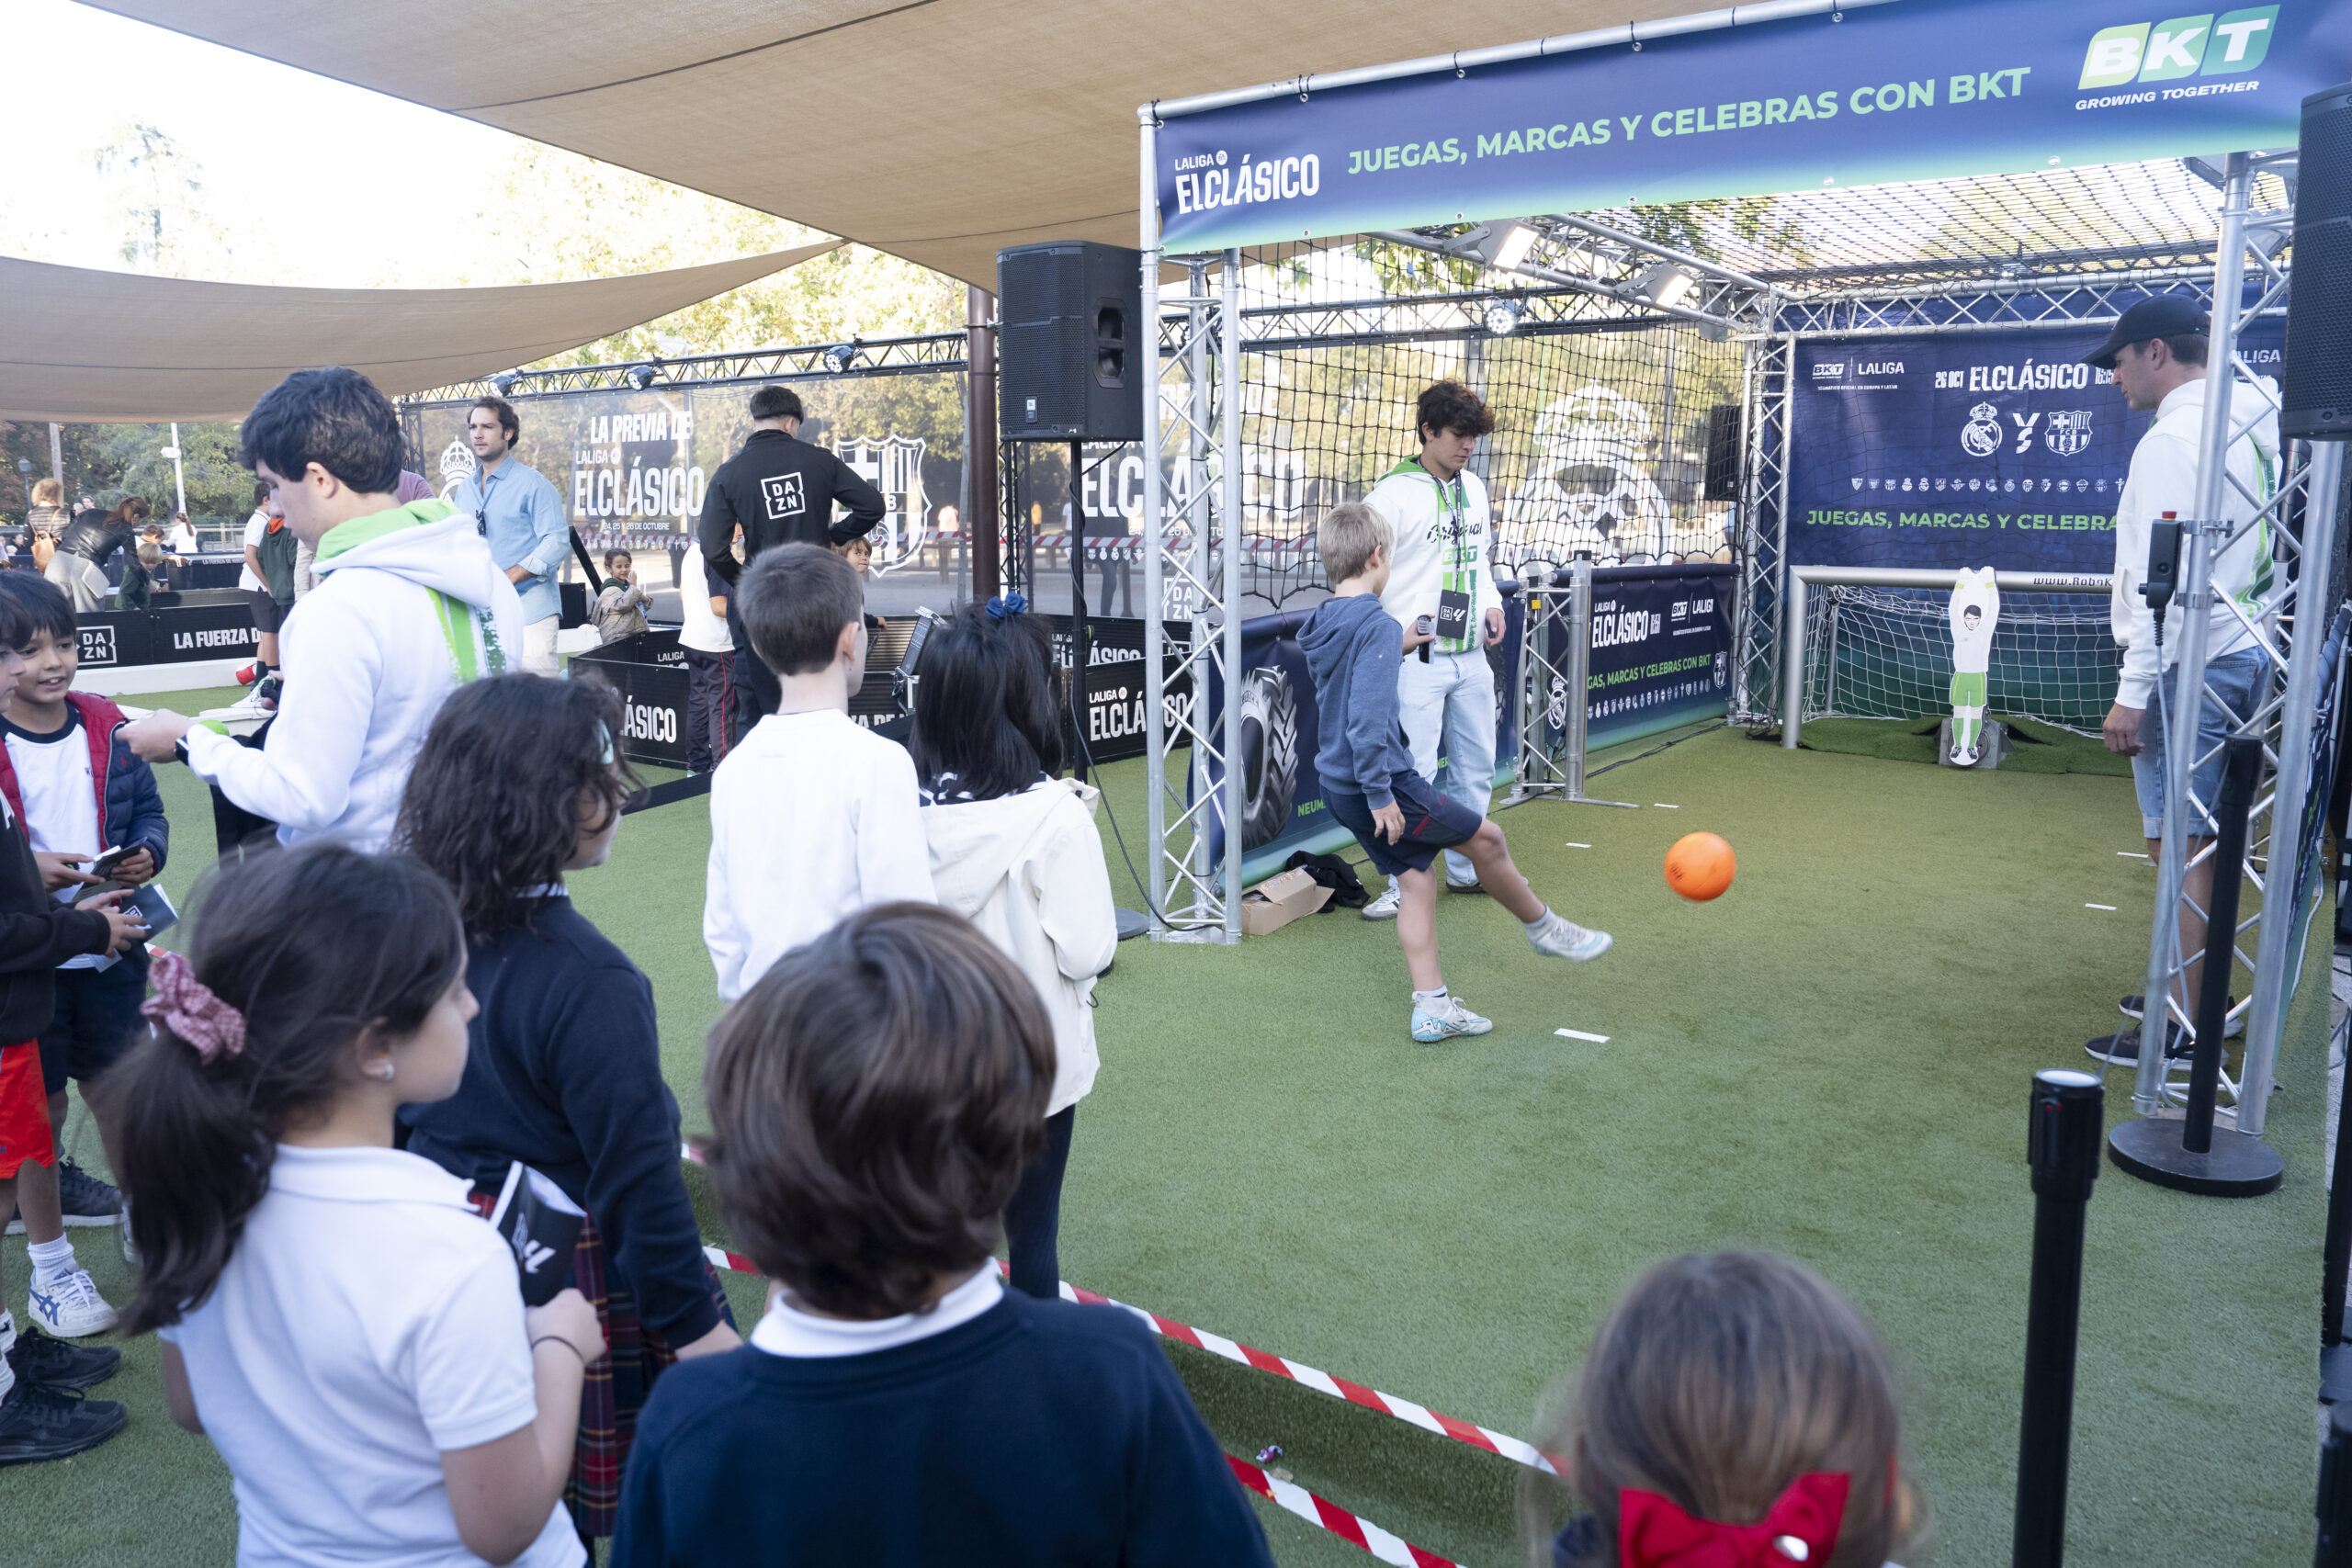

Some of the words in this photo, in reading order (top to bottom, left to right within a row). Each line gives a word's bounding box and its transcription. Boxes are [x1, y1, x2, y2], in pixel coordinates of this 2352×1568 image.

[2083, 17, 2271, 79] BKT
[2075, 89, 2155, 111] GROWING
[2161, 81, 2260, 102] TOGETHER
[1348, 137, 1468, 175] JUEGAS,
[1476, 118, 1611, 160] MARCAS
[1620, 116, 1644, 141] Y
[1652, 90, 1838, 139] CELEBRAS
[1849, 79, 1935, 116] CON
[1948, 67, 2031, 105] BKT
[1174, 153, 1215, 172] LALIGA
[1175, 153, 1320, 215] ELCLÁSICO
[1859, 362, 1905, 375] LALIGA
[2238, 350, 2281, 364] LIGA
[1948, 370, 1964, 388] OCT
[1969, 358, 2089, 391] ELCLÁSICO
[590, 416, 608, 444] LA
[612, 412, 668, 443] PREVIA
[671, 411, 691, 441] DE
[575, 450, 608, 465] LALIGA
[574, 456, 705, 517] ELCLÁSICO
[1806, 510, 1893, 530] JUEGAS,
[1899, 512, 1991, 529] MARCAS
[1997, 513, 2012, 529] Y
[2017, 513, 2118, 531] CELEBRA
[2033, 577, 2113, 587] www.RoboK
[174, 632, 194, 649] LA
[196, 628, 250, 649] FUERZA
[1592, 604, 1649, 649] ELCLÁSICO
[658, 650, 685, 662] LALIGA
[1588, 674, 1606, 690] GAS,
[1608, 667, 1639, 687] MARCAS
[1640, 666, 1646, 680] Y
[1646, 659, 1682, 678] CELEBRAS
[1683, 656, 1698, 671] CON
[1698, 653, 1712, 667] BKT
[1089, 689, 1118, 704] LALIGA
